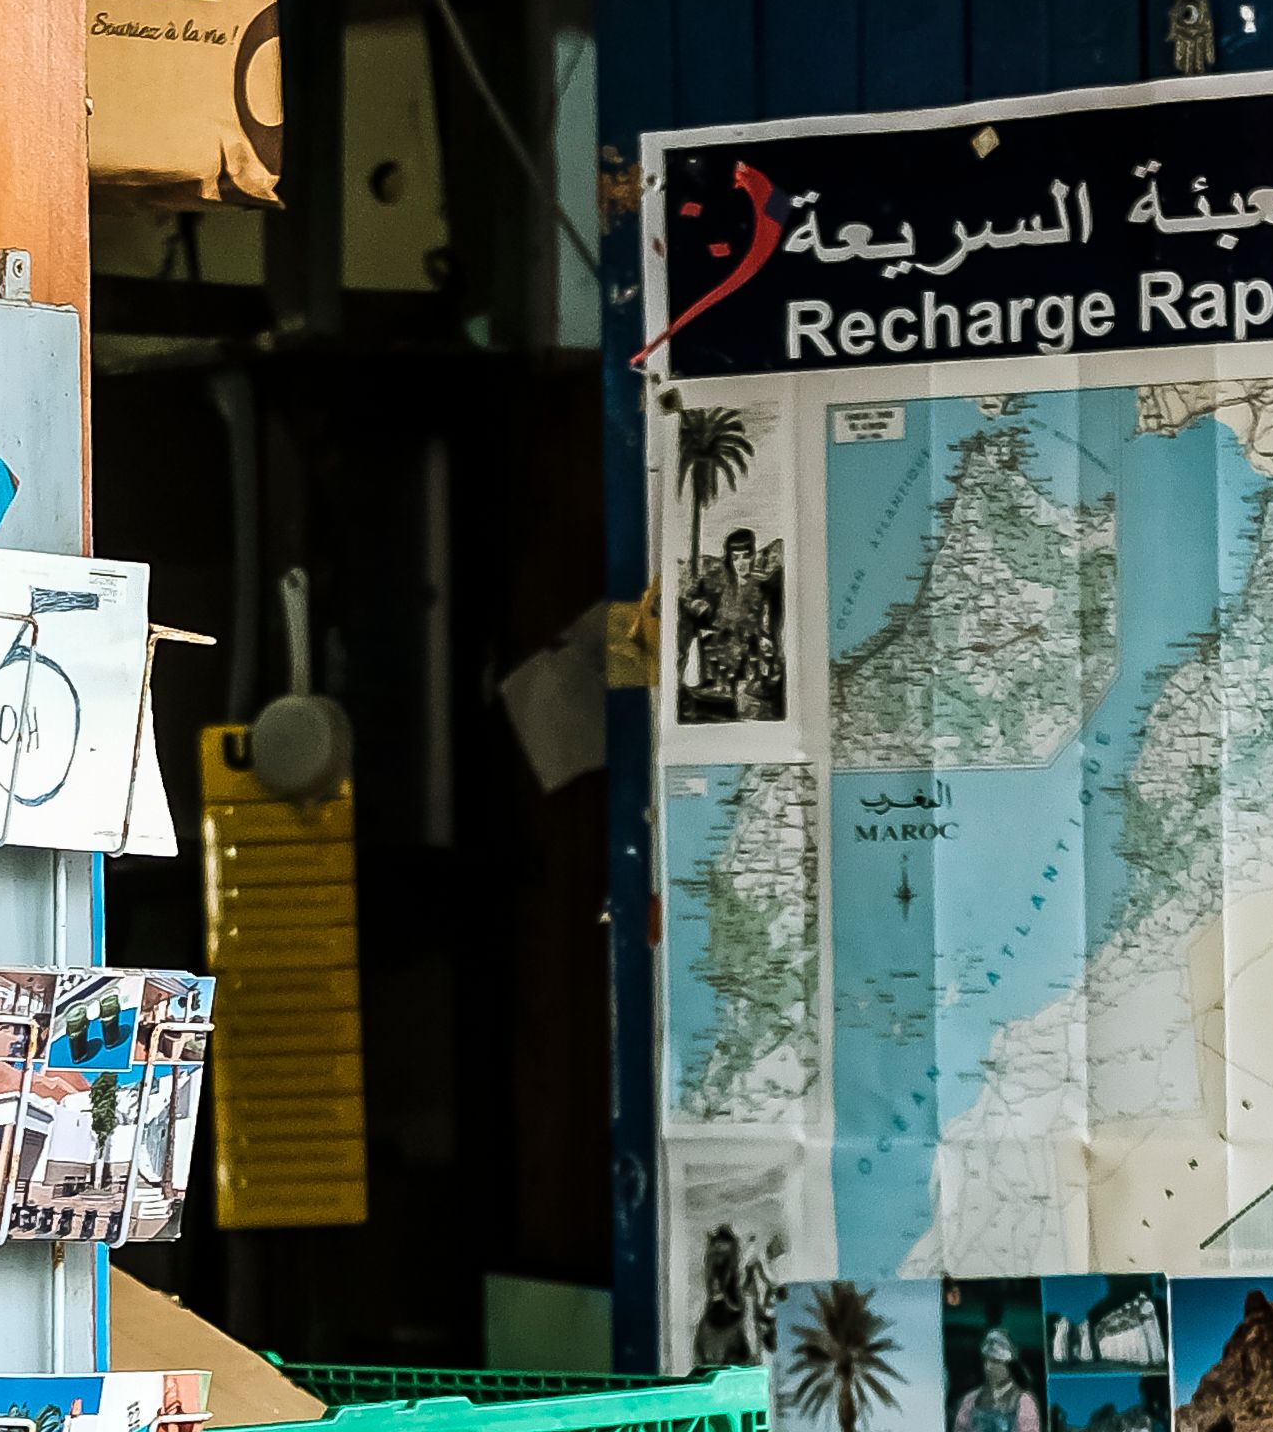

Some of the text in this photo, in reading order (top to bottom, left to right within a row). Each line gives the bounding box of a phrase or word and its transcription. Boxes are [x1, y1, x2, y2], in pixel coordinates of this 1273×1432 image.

[782, 178, 1094, 279] السريعة
[785, 290, 1116, 356] Recharge
[854, 821, 960, 842] MAROC
